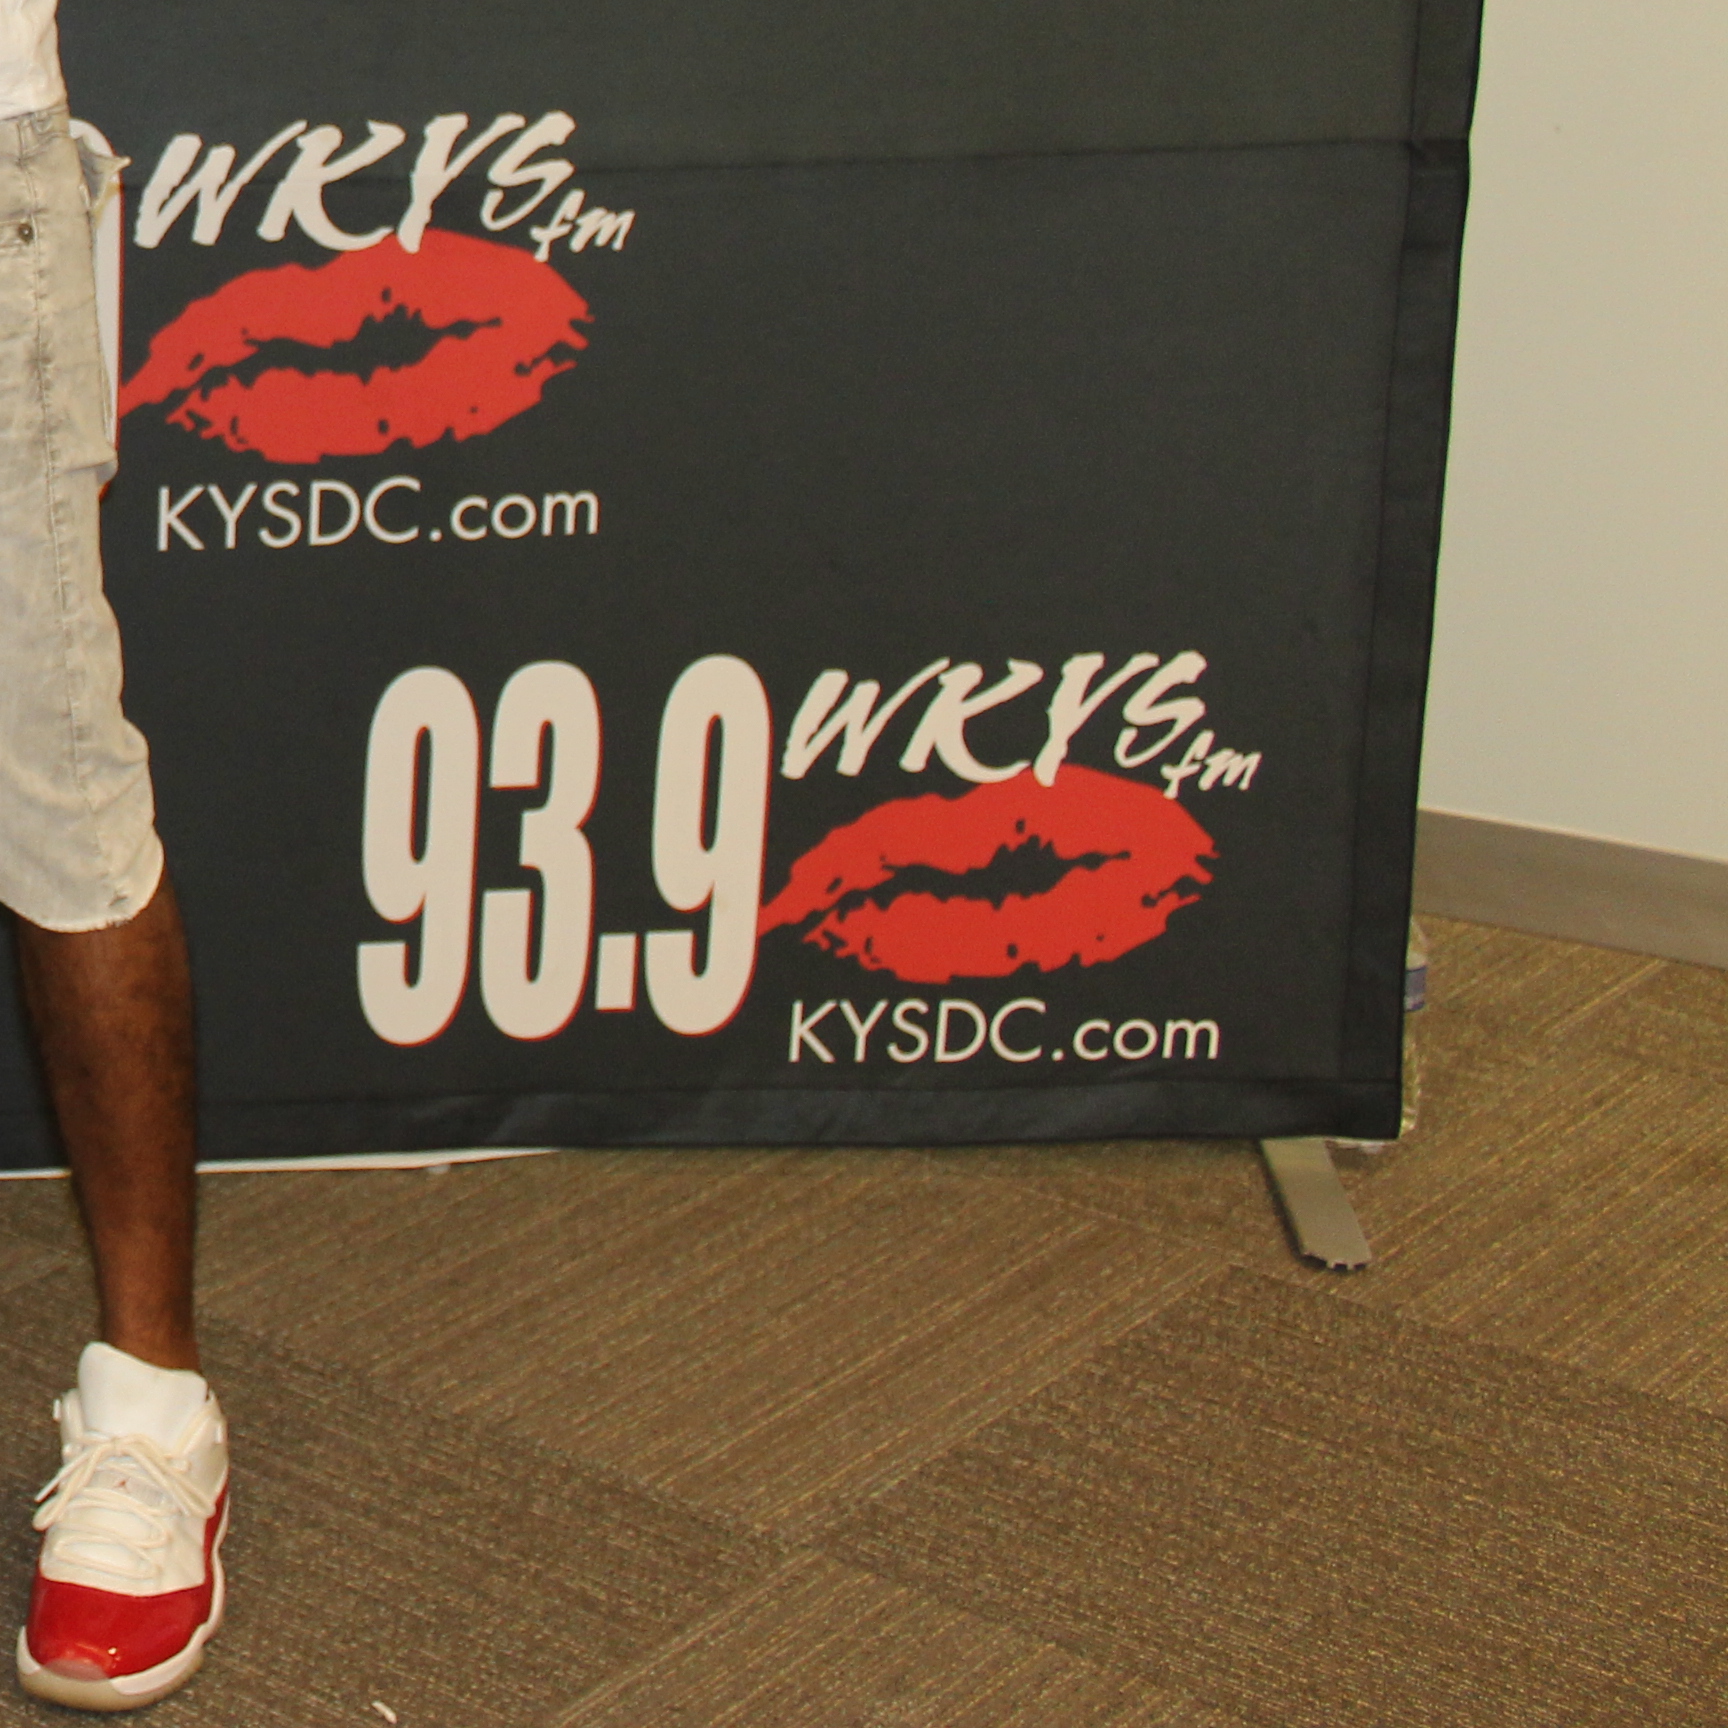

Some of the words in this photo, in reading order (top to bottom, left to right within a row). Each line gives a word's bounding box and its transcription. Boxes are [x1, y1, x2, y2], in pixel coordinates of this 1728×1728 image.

[134, 110, 576, 253] WKYS
[157, 476, 599, 551] KYSDC.com
[357, 655, 771, 1044] 93.9
[781, 650, 1206, 787] WKYS
[788, 999, 1219, 1063] KYSDC.com
